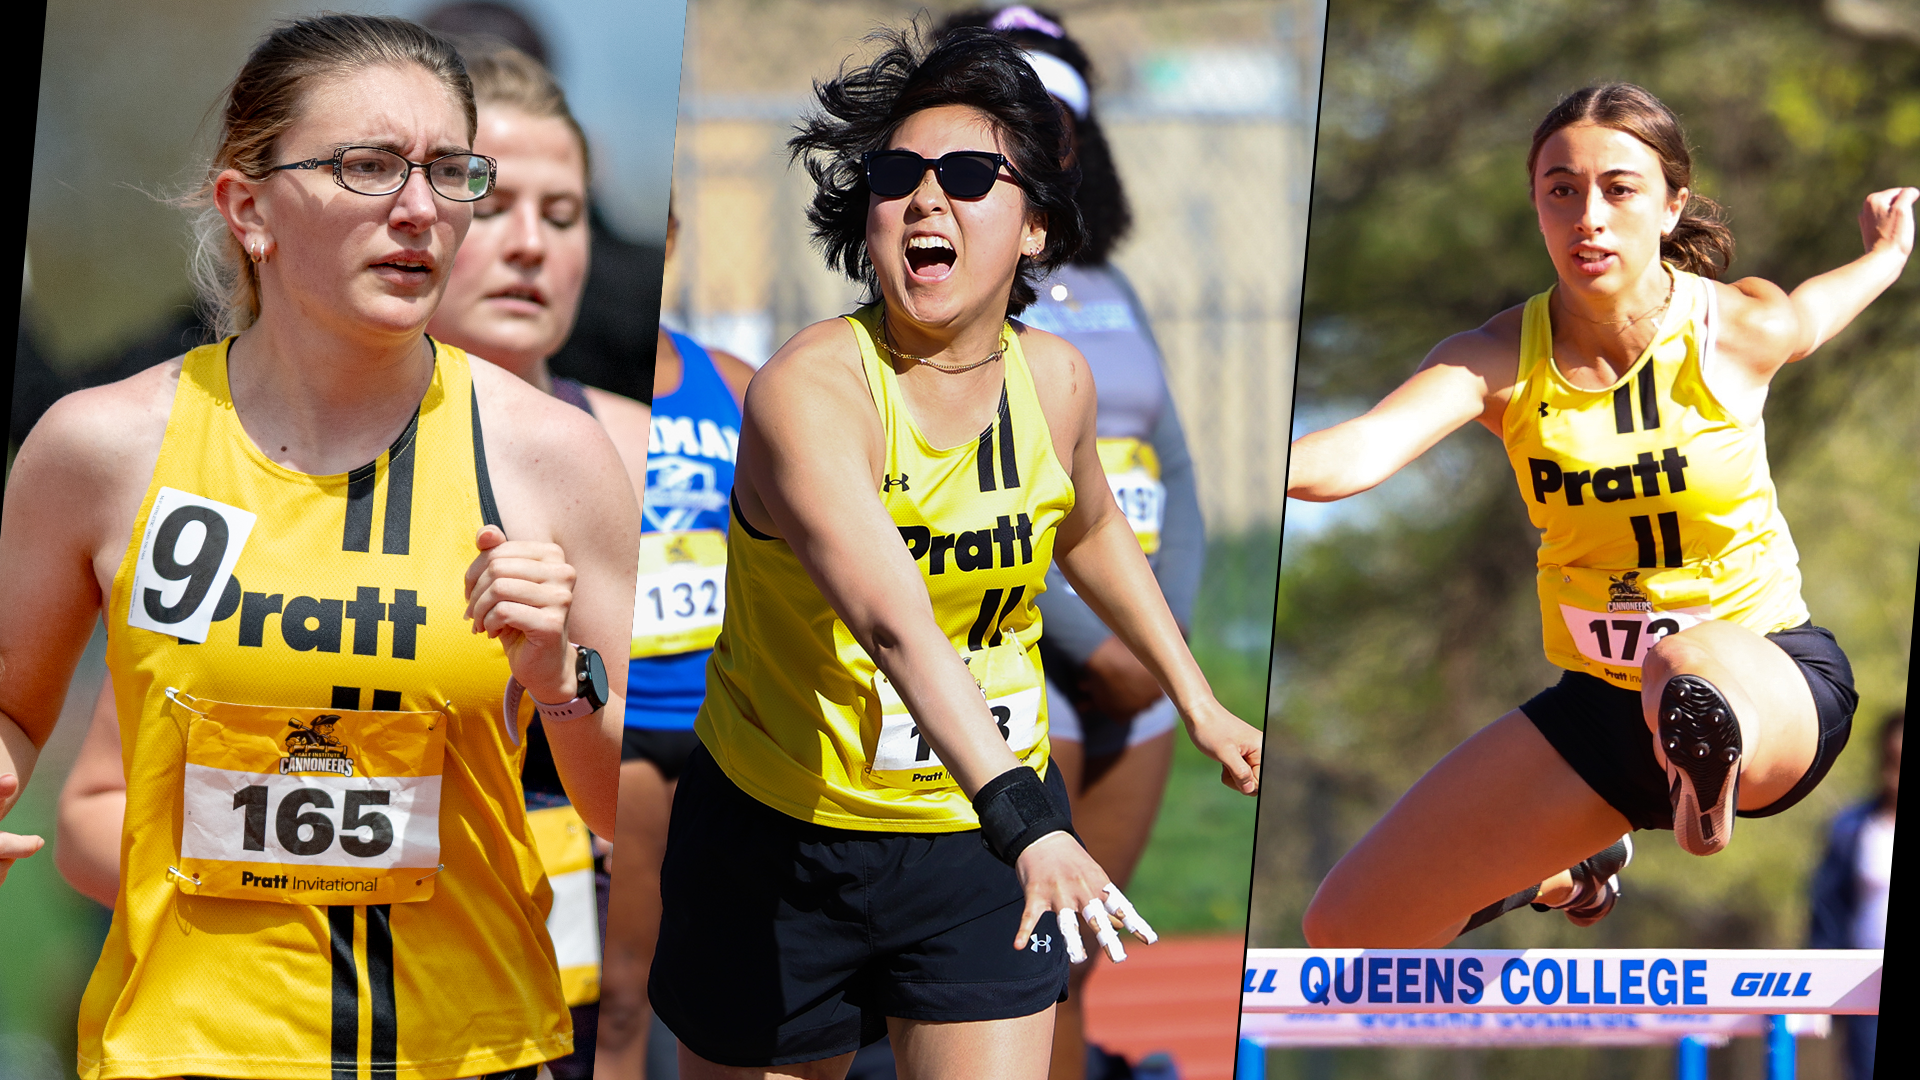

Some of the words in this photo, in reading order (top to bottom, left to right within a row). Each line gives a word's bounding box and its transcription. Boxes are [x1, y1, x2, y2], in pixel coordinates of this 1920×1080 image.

[1528, 447, 1688, 506] Pratt
[143, 505, 229, 624] 9
[897, 513, 1033, 575] Pratt
[648, 578, 718, 621] 132
[1607, 601, 1653, 613] CANNONEERS
[1604, 668, 1628, 682] Pratt
[279, 757, 354, 777] CANNONEERS
[912, 771, 943, 783] Pratt
[233, 785, 394, 857] 165
[241, 871, 289, 889] Pratt
[292, 876, 378, 892] Invitational
[1300, 956, 1484, 1006] QUEENS
[1500, 957, 1708, 1006] COLLEGE
[1731, 972, 1812, 997] GILL
